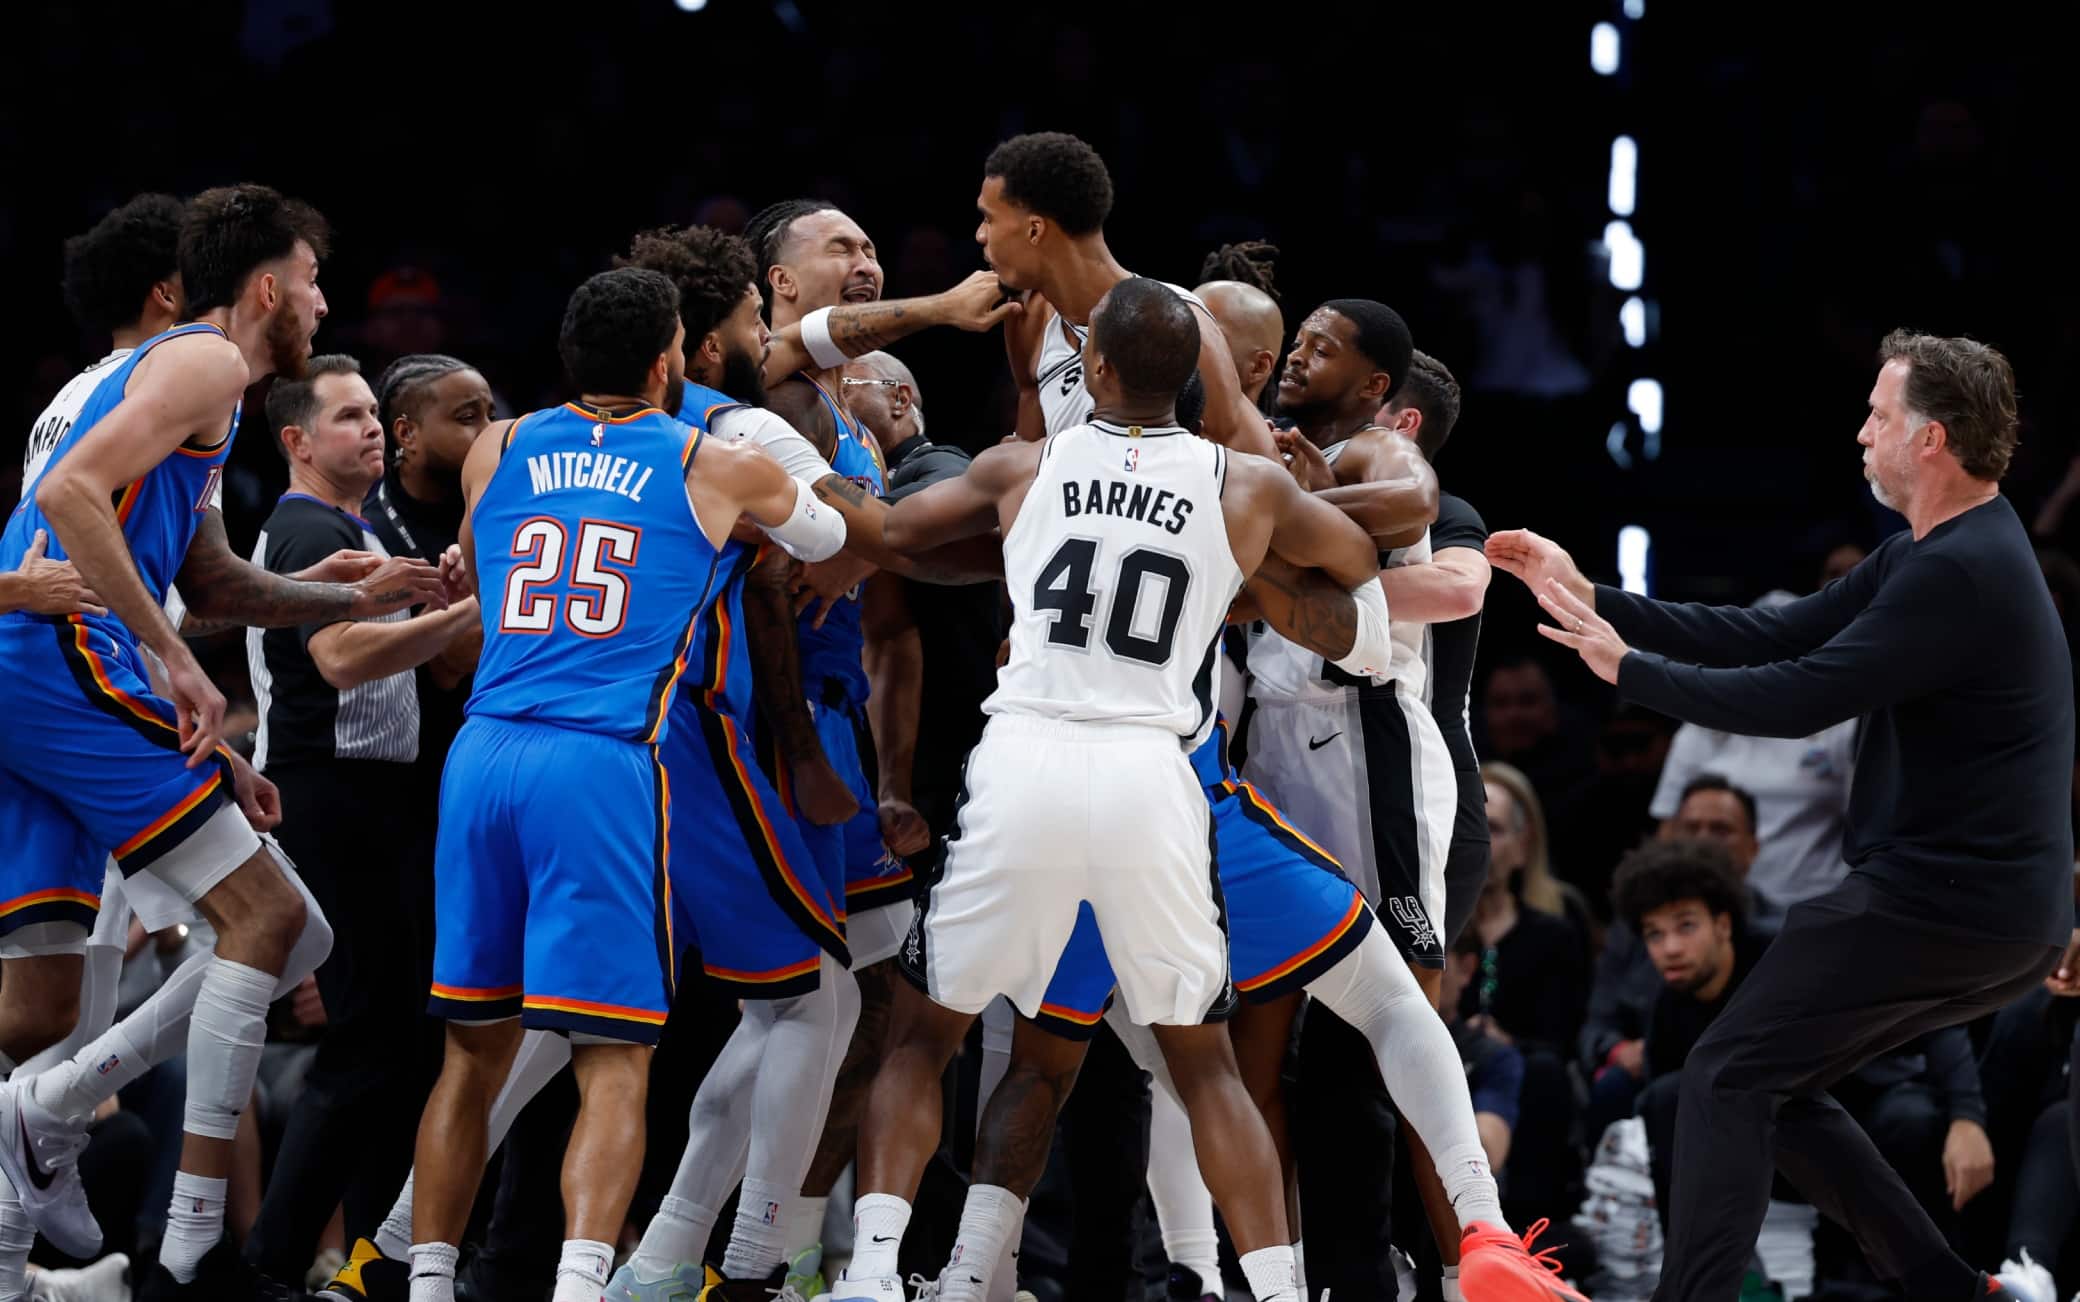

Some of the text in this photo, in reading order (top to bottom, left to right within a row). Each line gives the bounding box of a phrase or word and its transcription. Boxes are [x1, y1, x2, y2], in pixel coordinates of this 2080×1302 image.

[527, 451, 654, 503] MITCHELL
[1062, 479, 1194, 536] BARNES
[498, 515, 643, 640] 25
[1031, 533, 1195, 672] 40
